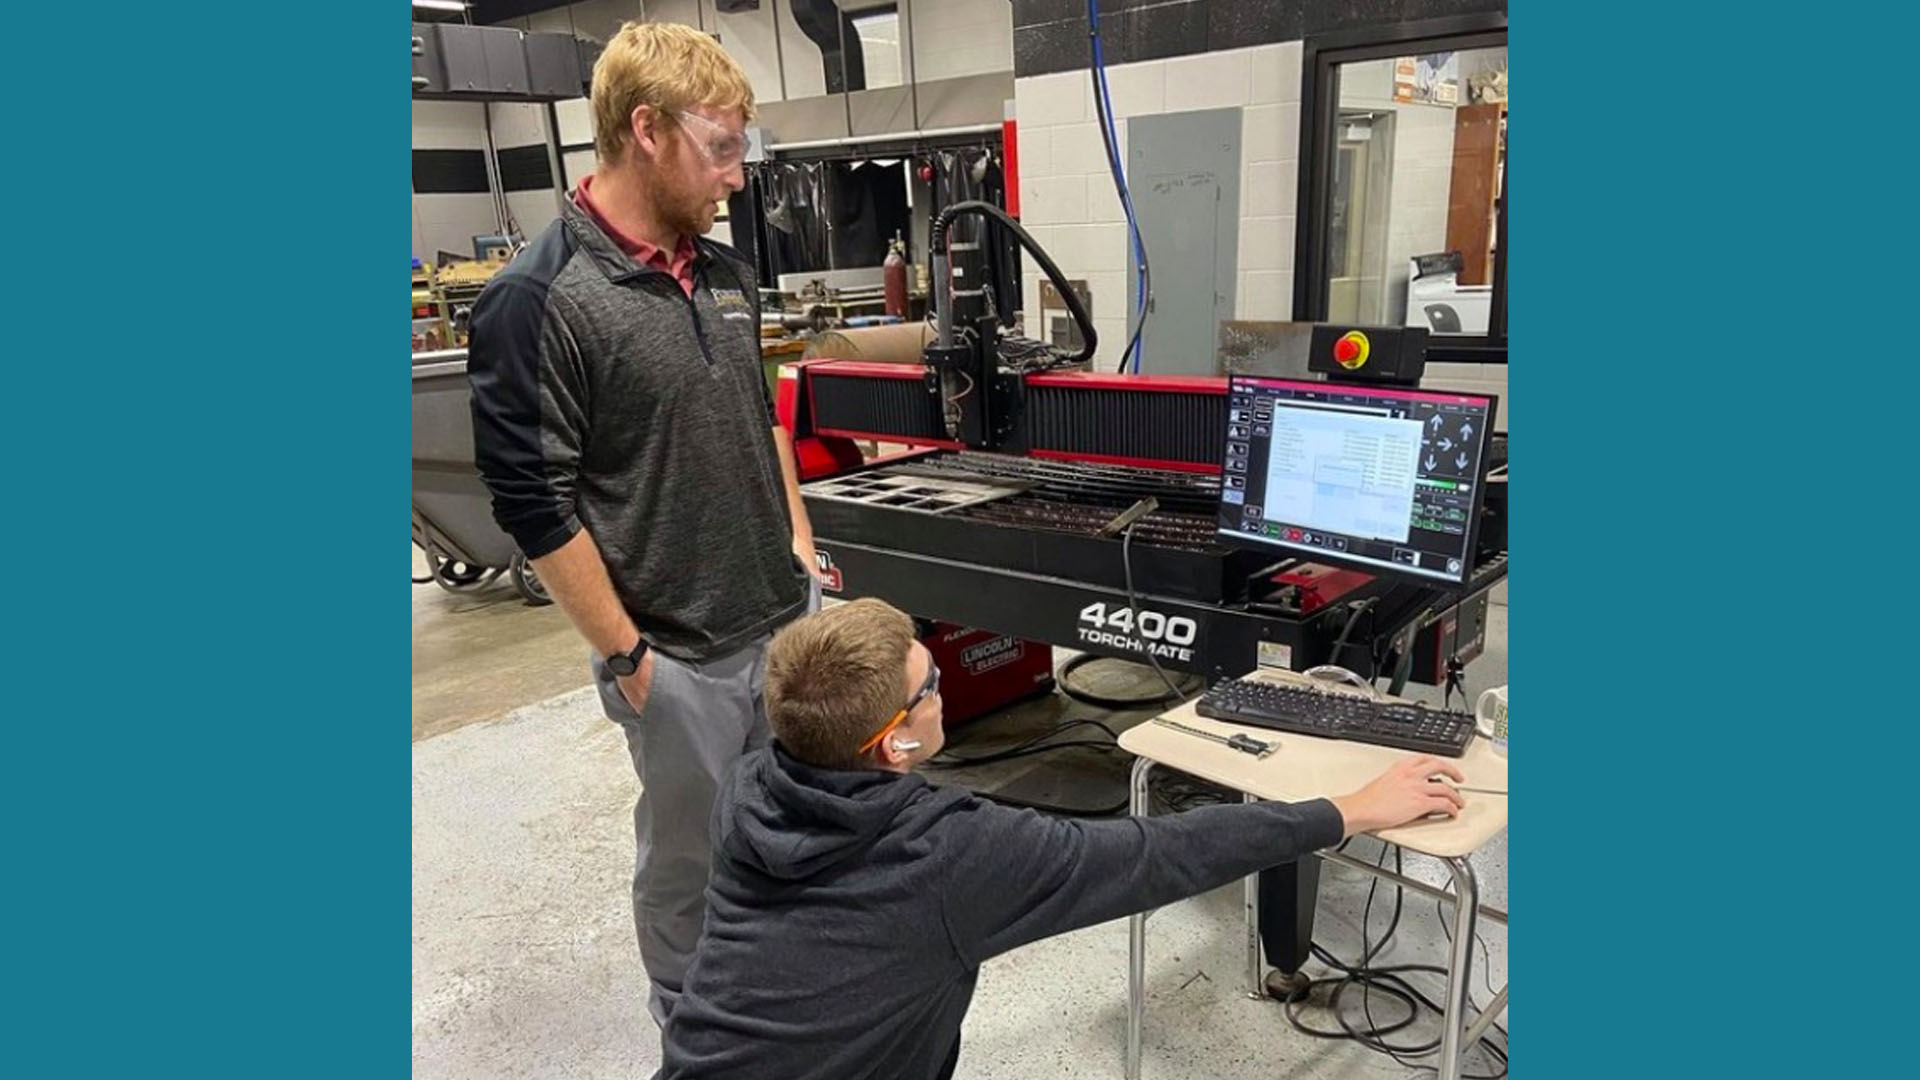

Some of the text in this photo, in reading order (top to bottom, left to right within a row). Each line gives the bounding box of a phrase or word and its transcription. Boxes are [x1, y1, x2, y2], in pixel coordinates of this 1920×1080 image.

[1079, 602, 1197, 646] 4400
[964, 636, 1013, 662] LINCOLN
[976, 648, 1019, 671] ELECTRIC
[1078, 628, 1192, 662] TORCHMATE
